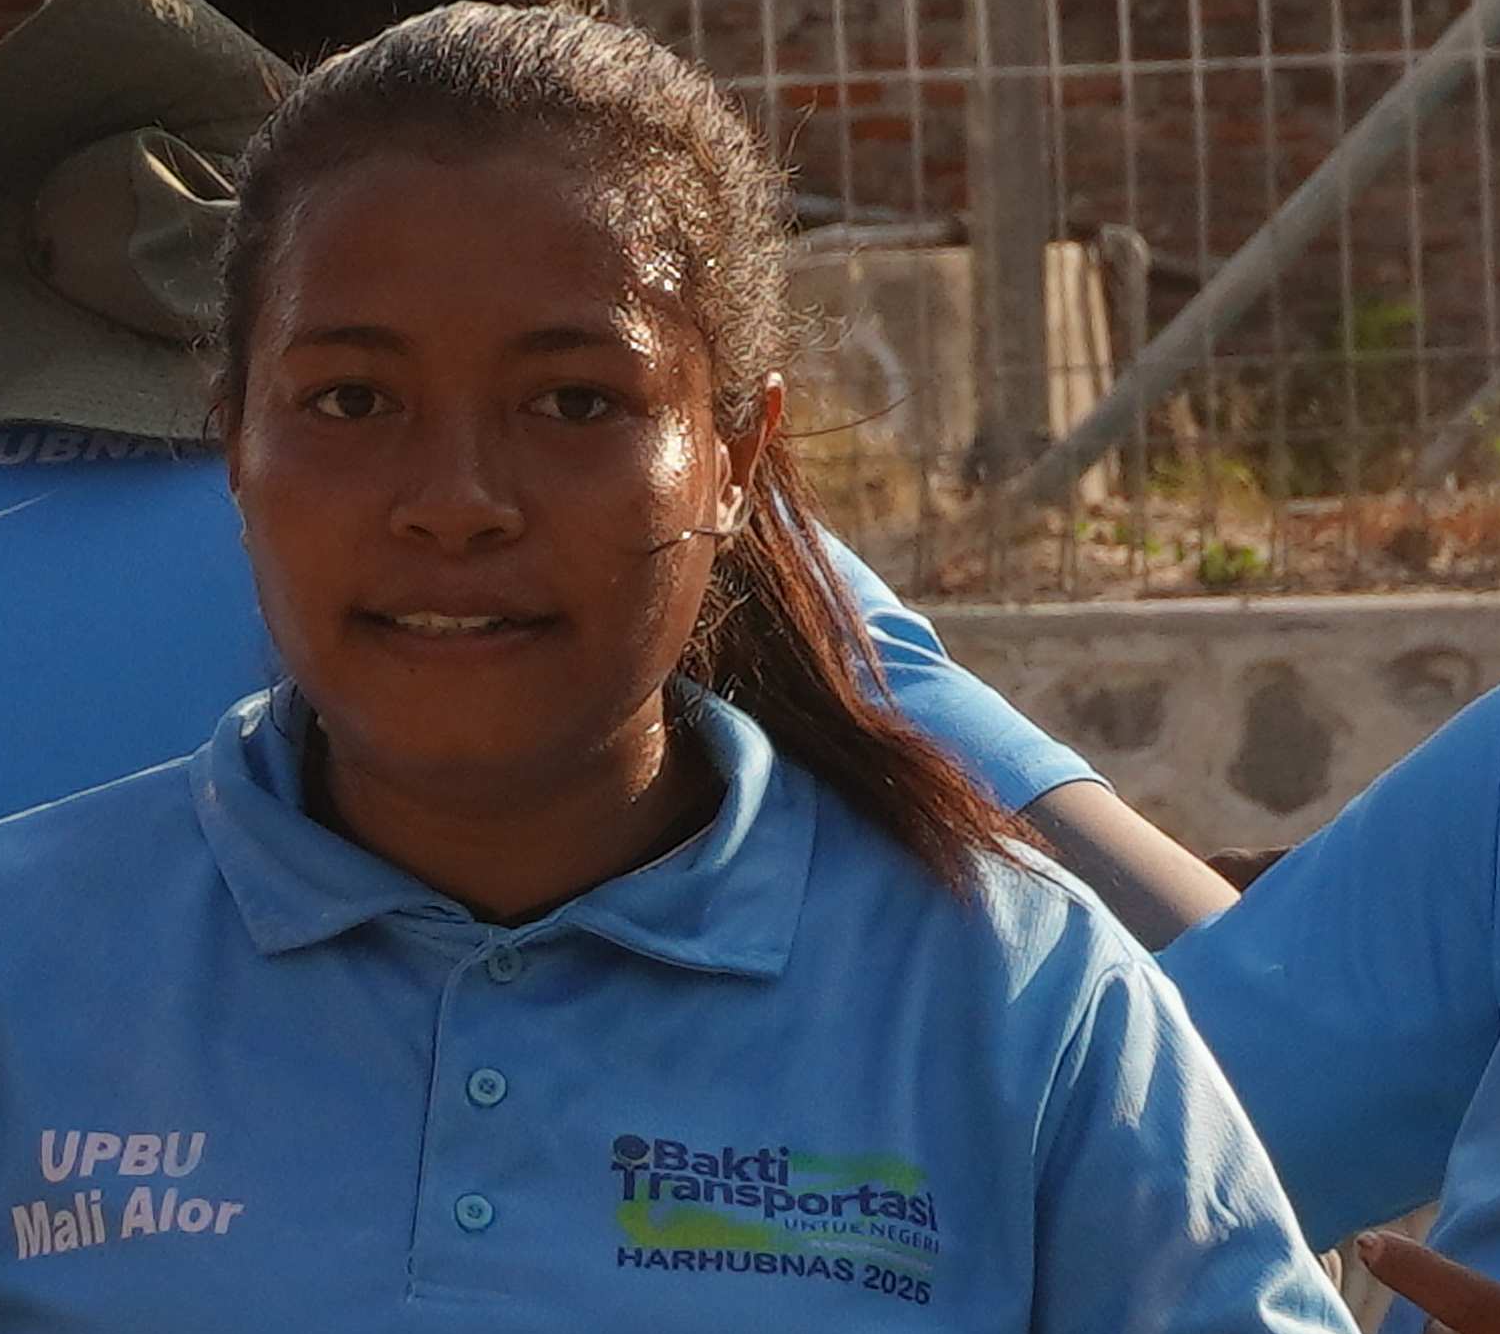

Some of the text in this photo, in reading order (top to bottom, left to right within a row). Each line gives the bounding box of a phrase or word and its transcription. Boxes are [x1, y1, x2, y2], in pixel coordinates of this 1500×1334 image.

[41, 1130, 206, 1183] UPBU
[654, 1138, 790, 1186] Bakti
[12, 1186, 244, 1260] Mali Alor
[611, 1162, 939, 1233] Transportasi
[869, 1222, 940, 1255] NEGERI
[616, 1246, 932, 1306] HARHUBNAS 2025
